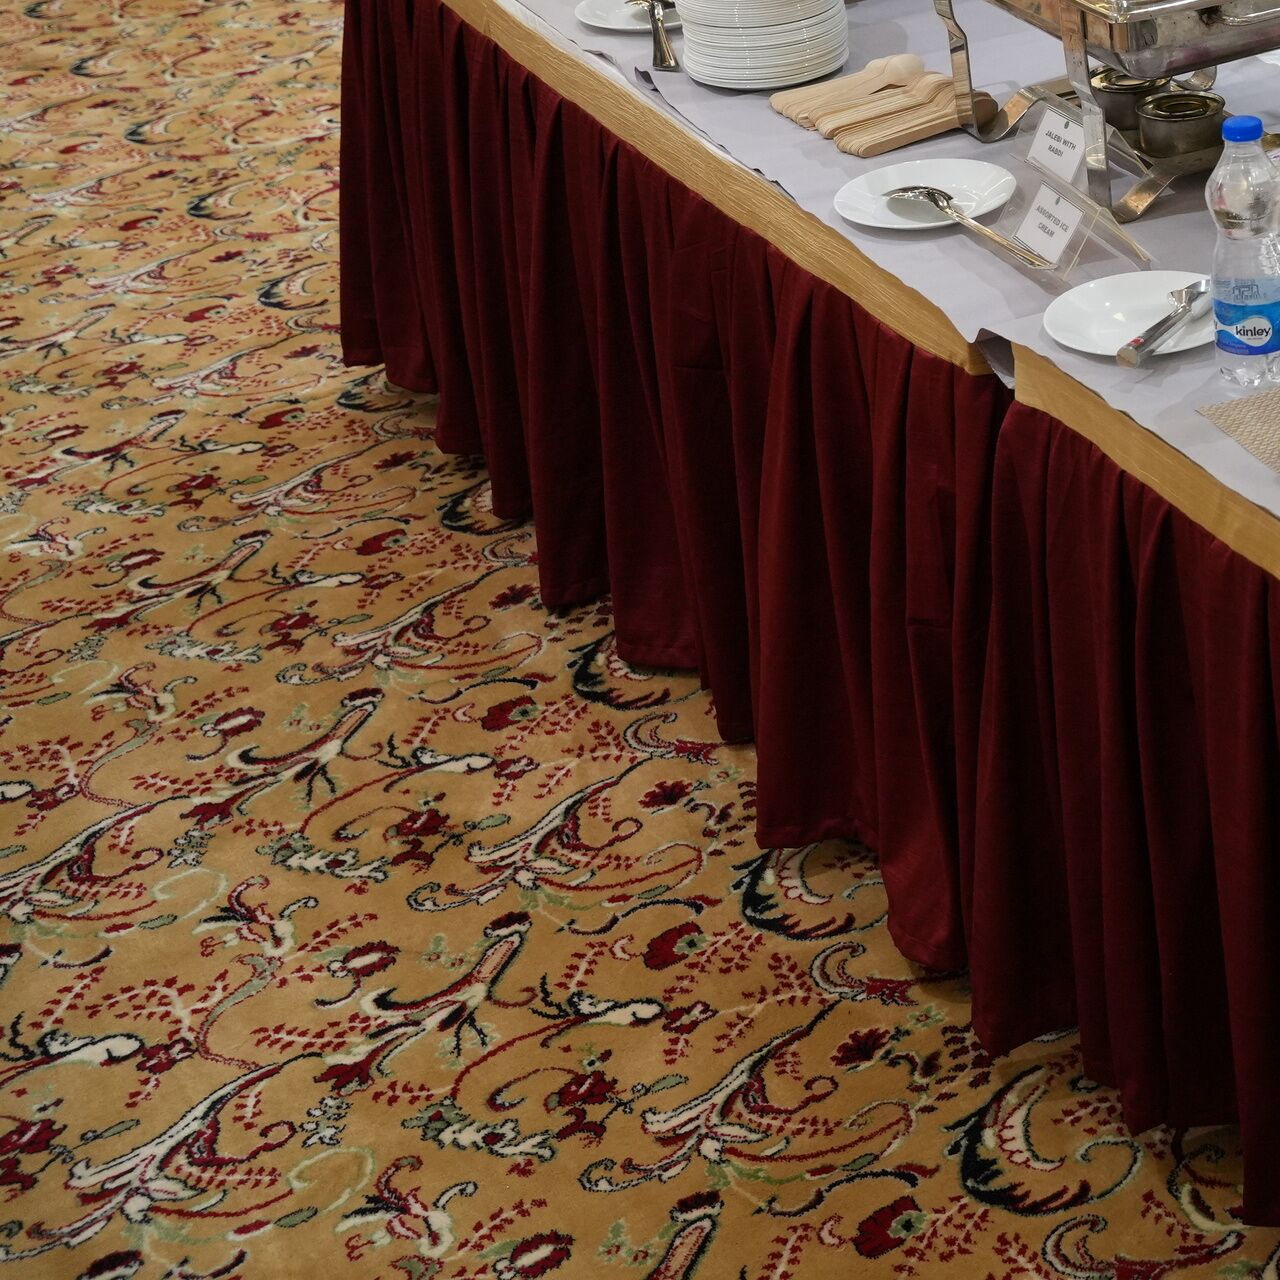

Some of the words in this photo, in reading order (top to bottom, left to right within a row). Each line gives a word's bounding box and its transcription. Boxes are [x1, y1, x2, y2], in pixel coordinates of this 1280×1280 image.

[1045, 129, 1063, 143] JALEBI
[1062, 139, 1077, 151] WITH
[1036, 204, 1061, 226] ASSORTED
[1059, 222, 1070, 233] ICE
[1037, 222, 1055, 238] CREAM
[1235, 325, 1271, 337] kinley
